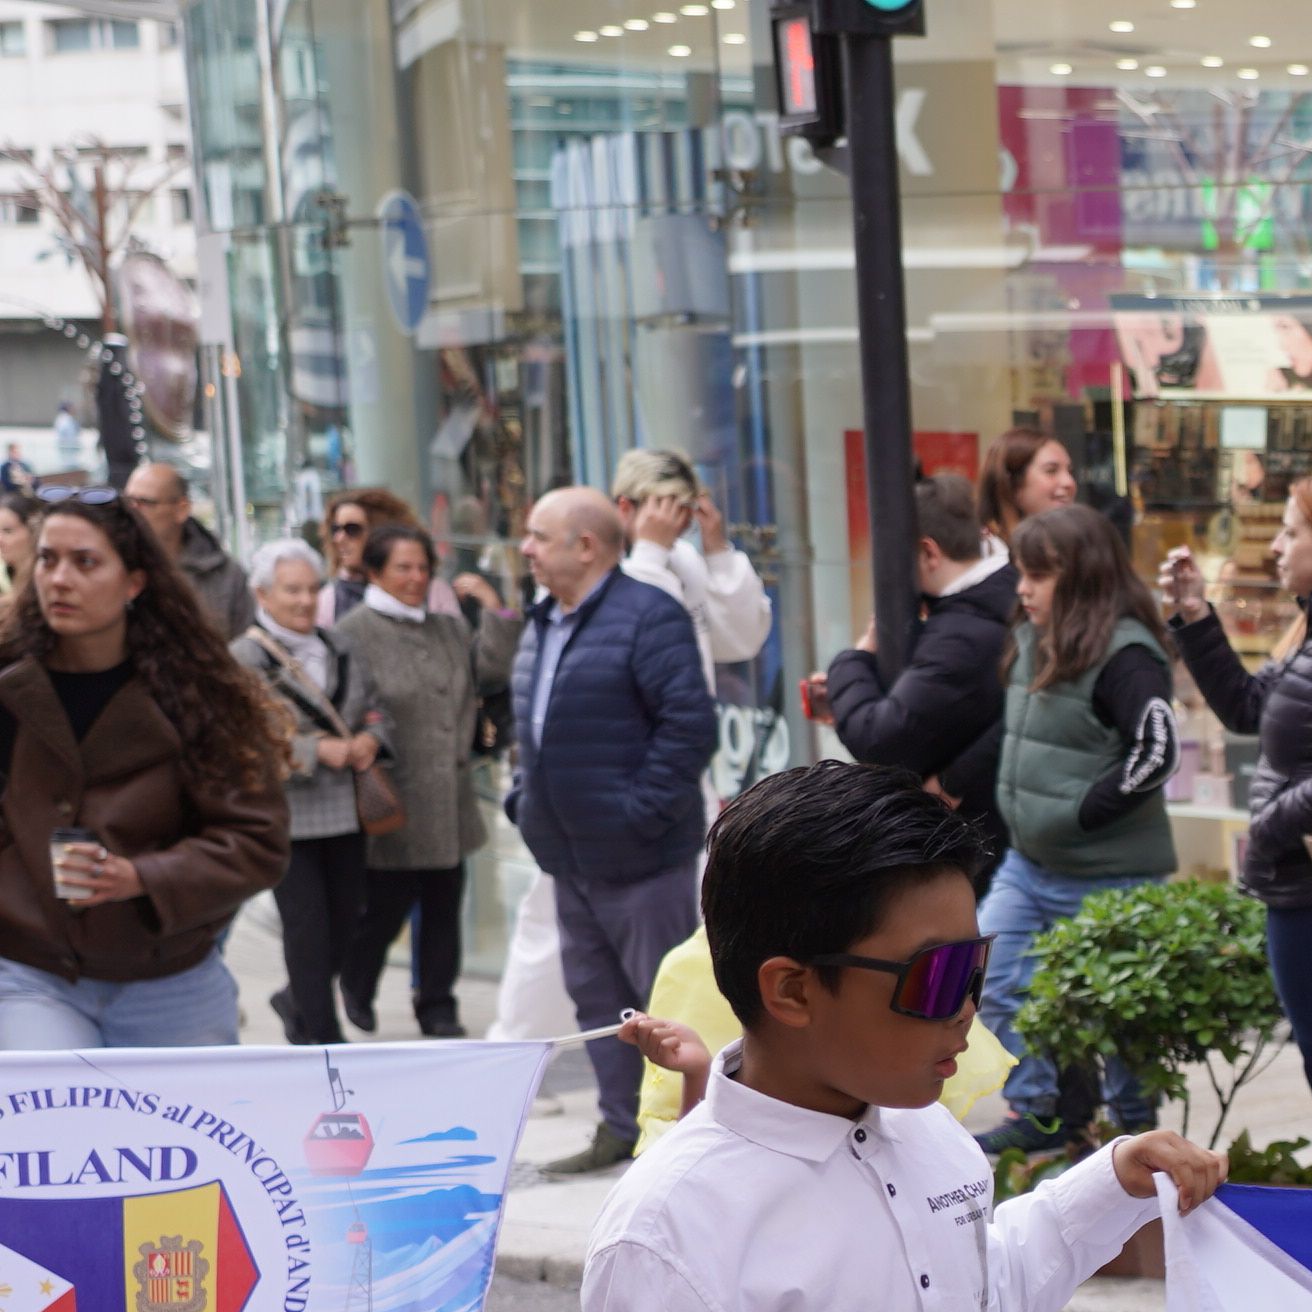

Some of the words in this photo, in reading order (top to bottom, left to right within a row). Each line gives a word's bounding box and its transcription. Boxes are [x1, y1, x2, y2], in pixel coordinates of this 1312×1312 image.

[7, 1086, 161, 1115] FILIPINS
[162, 1104, 193, 1124] al
[190, 1108, 307, 1226] PRINCIPAT
